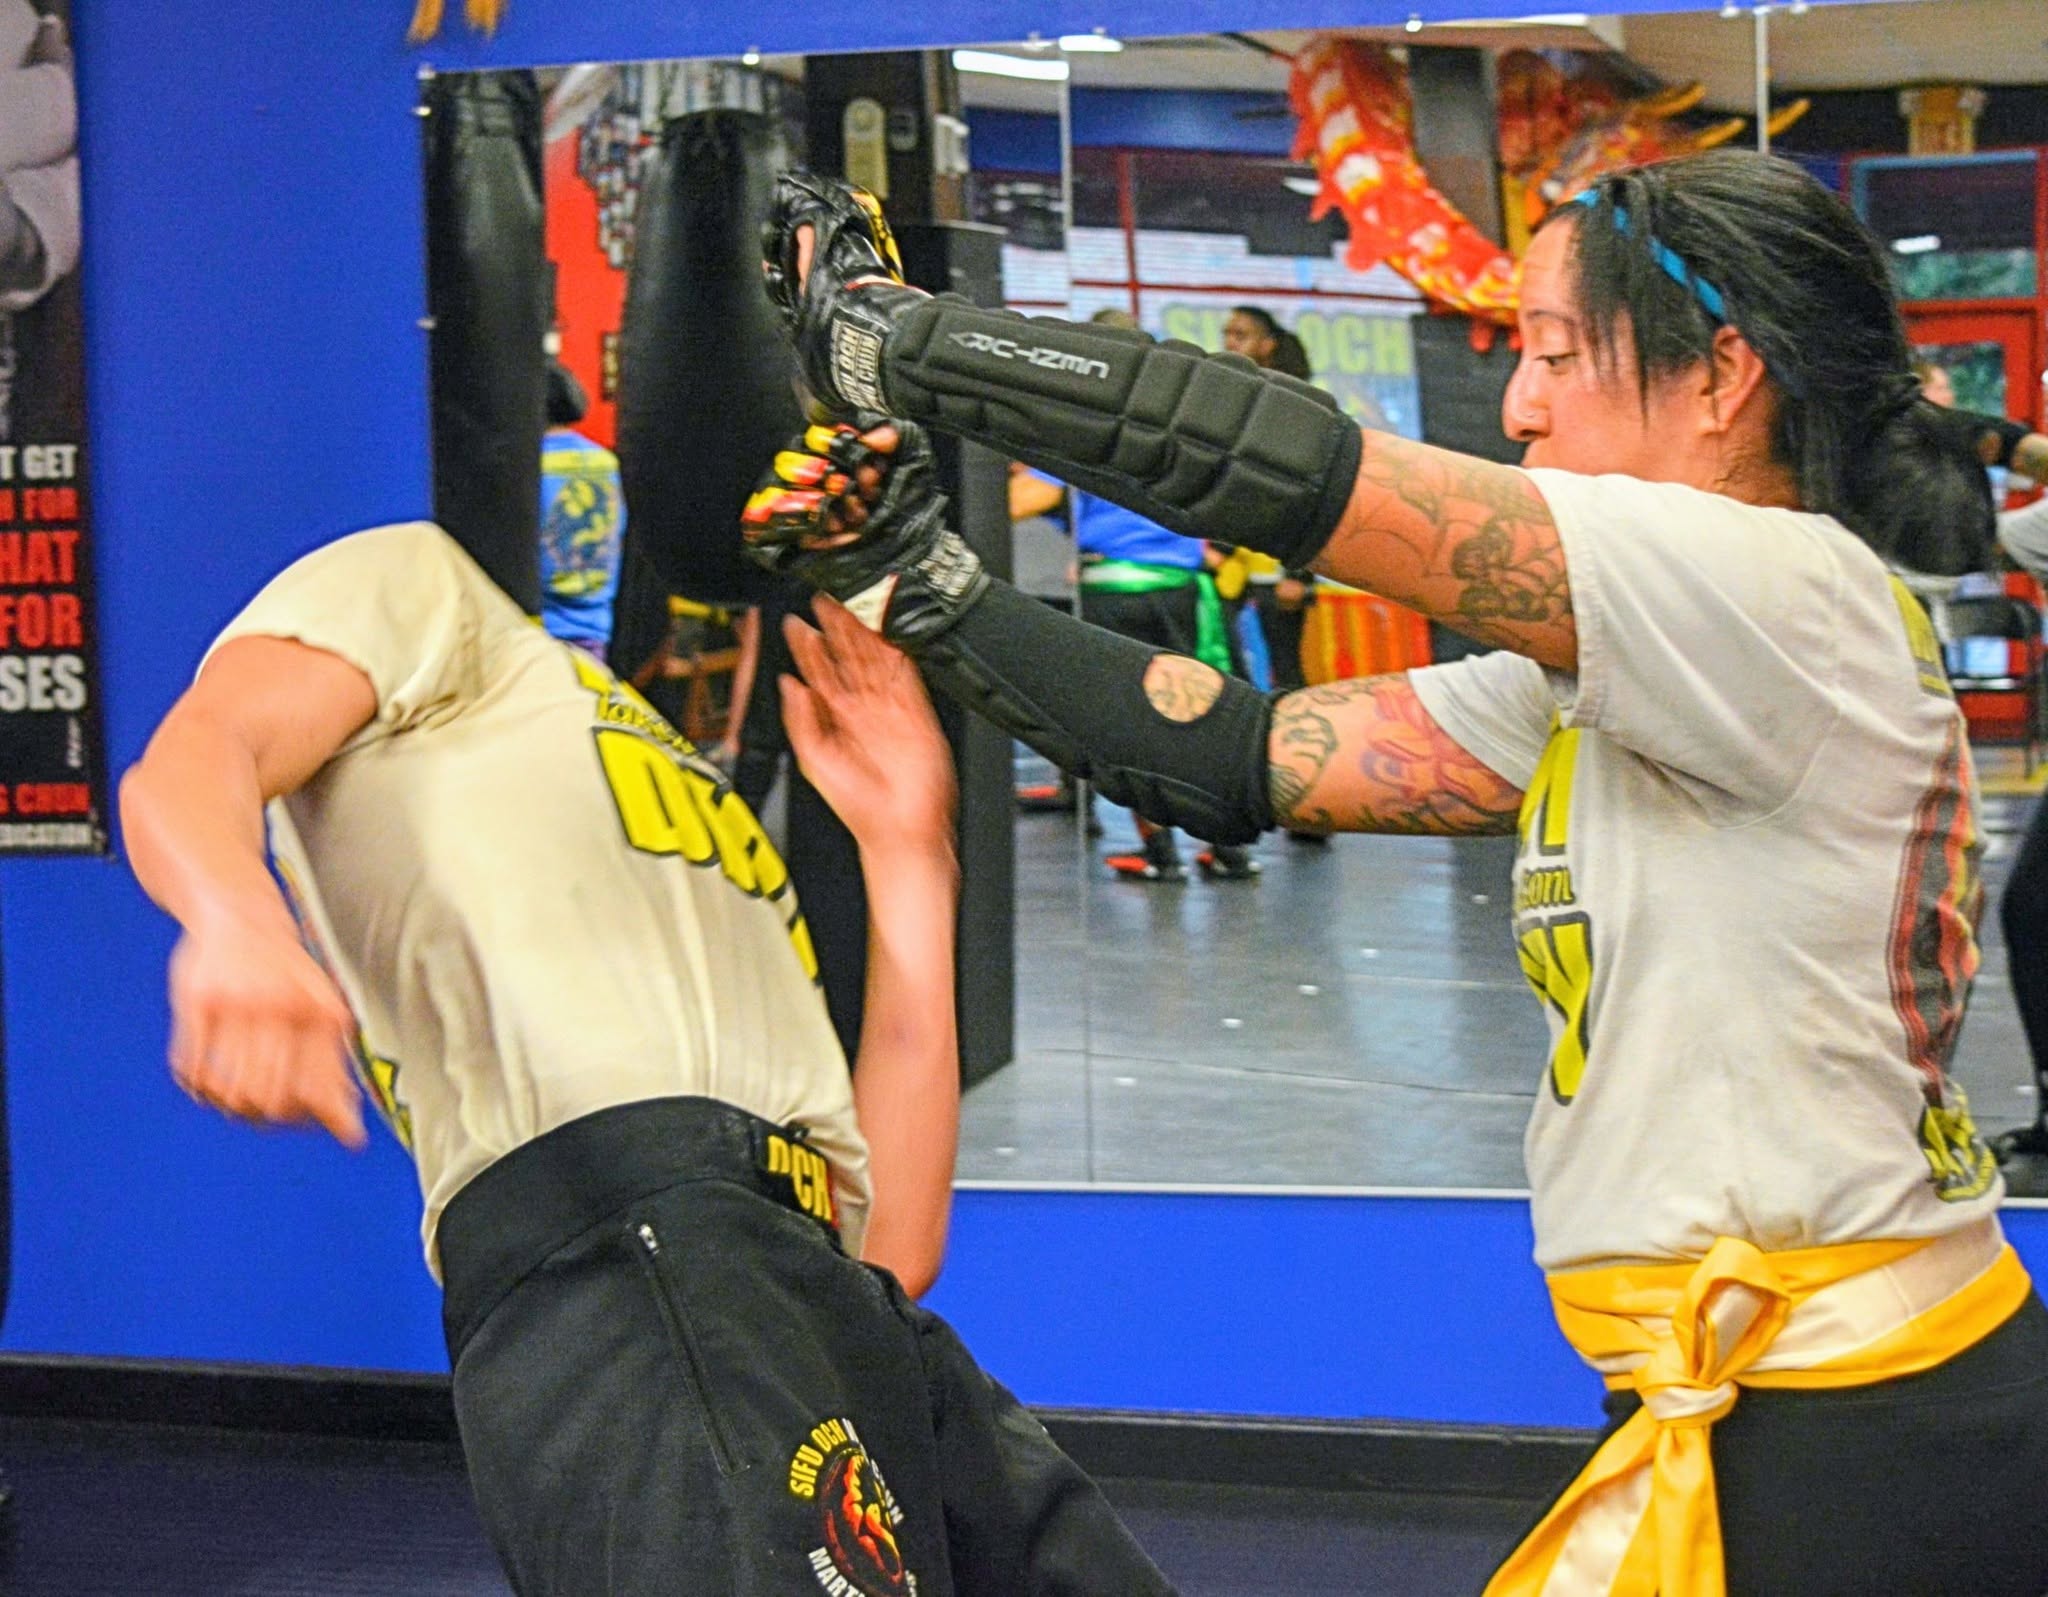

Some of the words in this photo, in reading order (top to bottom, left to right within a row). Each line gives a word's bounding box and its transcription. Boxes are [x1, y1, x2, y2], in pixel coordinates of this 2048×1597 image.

[23, 444, 78, 480] GET
[23, 488, 79, 521] FOR
[789, 1443, 825, 1498] SIFU
[810, 1417, 848, 1453] OCH
